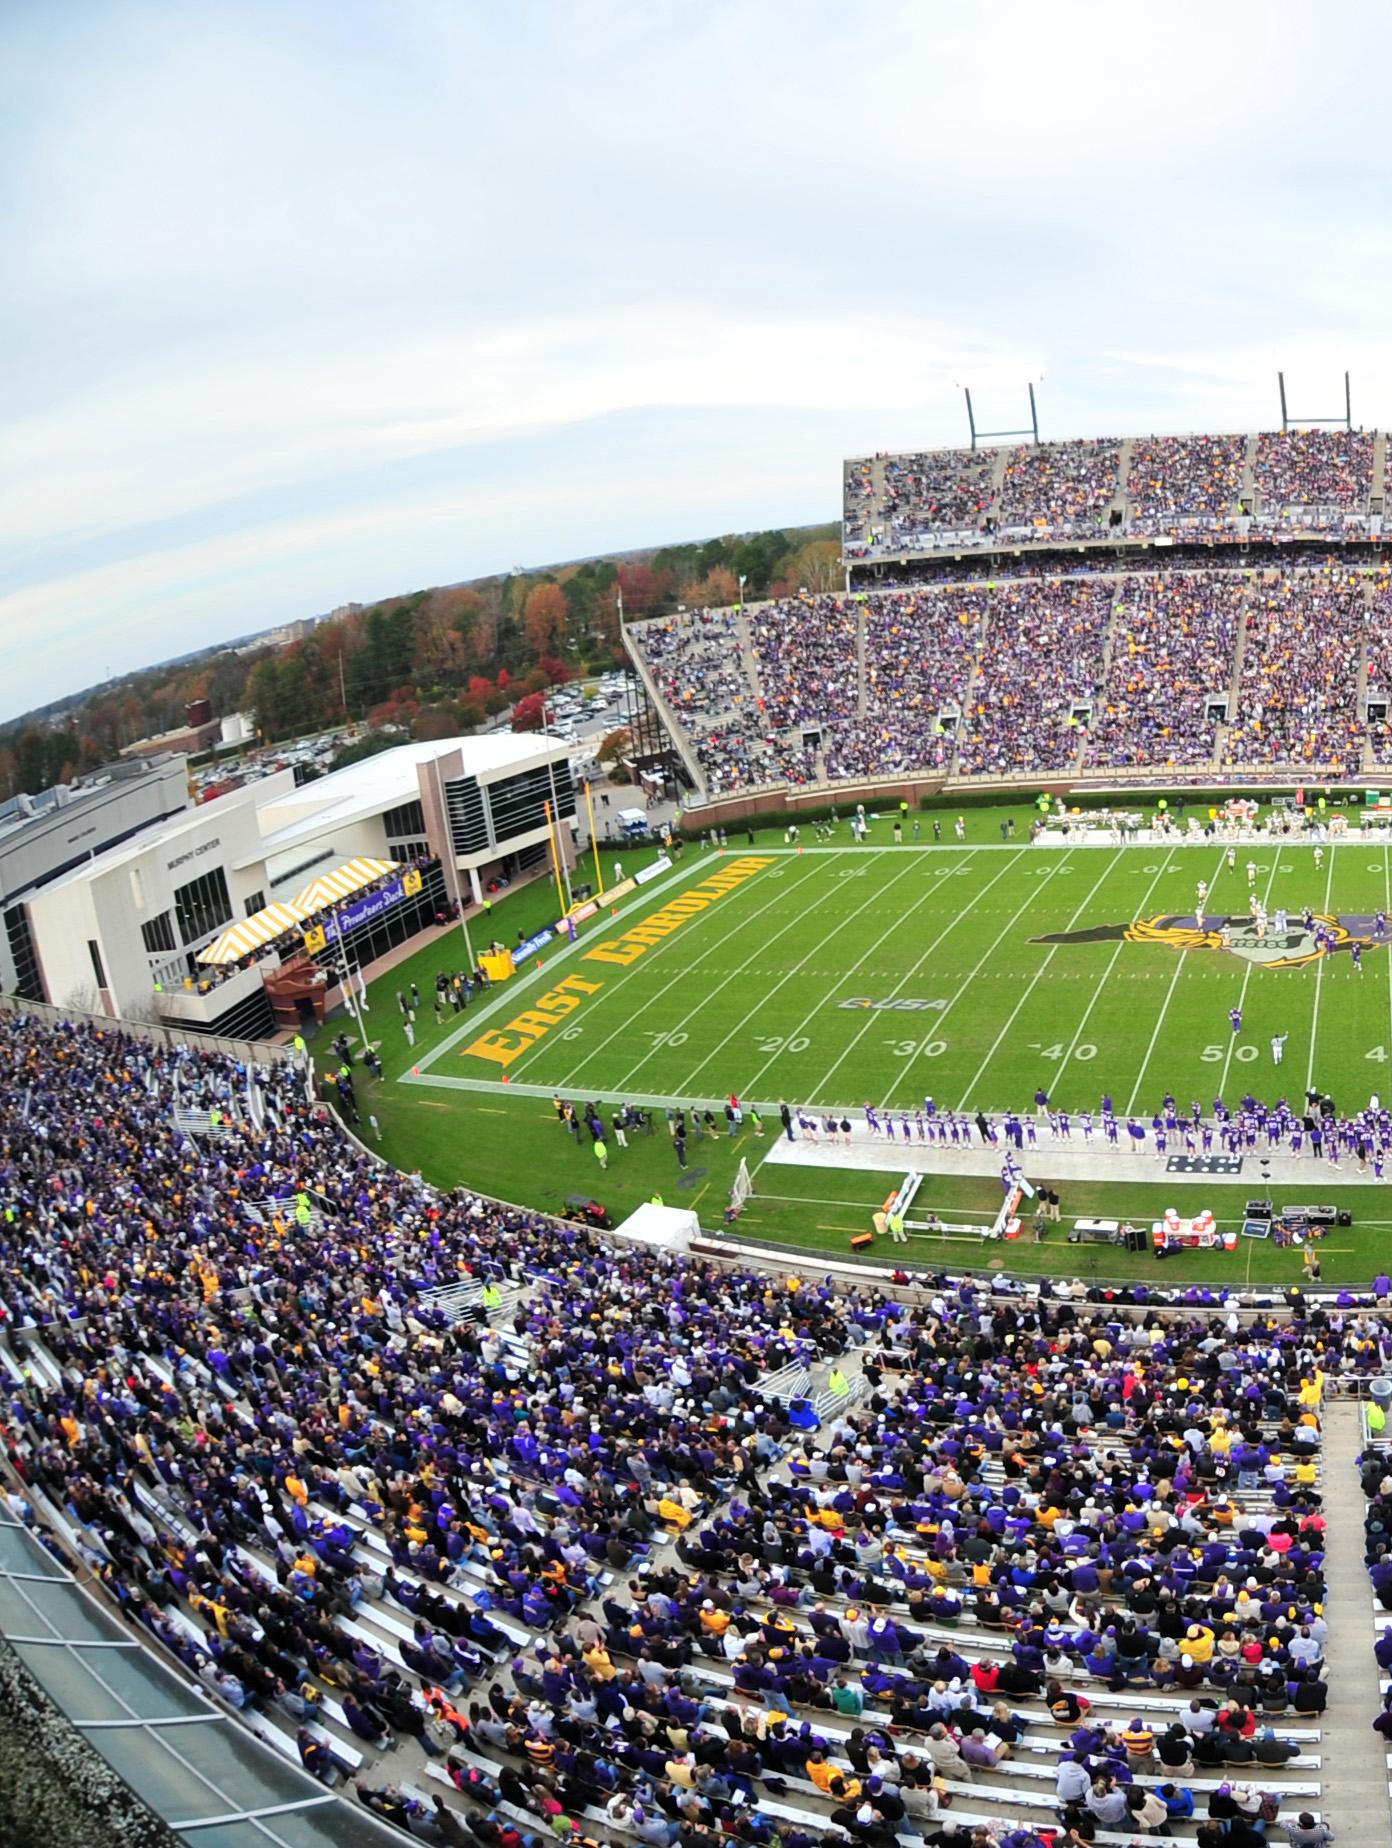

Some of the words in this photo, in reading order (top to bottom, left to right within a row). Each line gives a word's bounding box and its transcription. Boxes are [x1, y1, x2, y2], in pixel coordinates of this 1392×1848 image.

[167, 851, 194, 870] MURPHY
[195, 838, 220, 856] CENTER
[383, 883, 404, 906] Deck
[580, 856, 778, 966] CAROLINA
[459, 974, 604, 1068] EAST
[563, 1028, 583, 1040] G
[654, 1032, 688, 1047] 10
[759, 1037, 810, 1053] 20
[893, 1040, 947, 1058] 30
[1041, 1044, 1098, 1061] 40
[1200, 1045, 1259, 1062] 50
